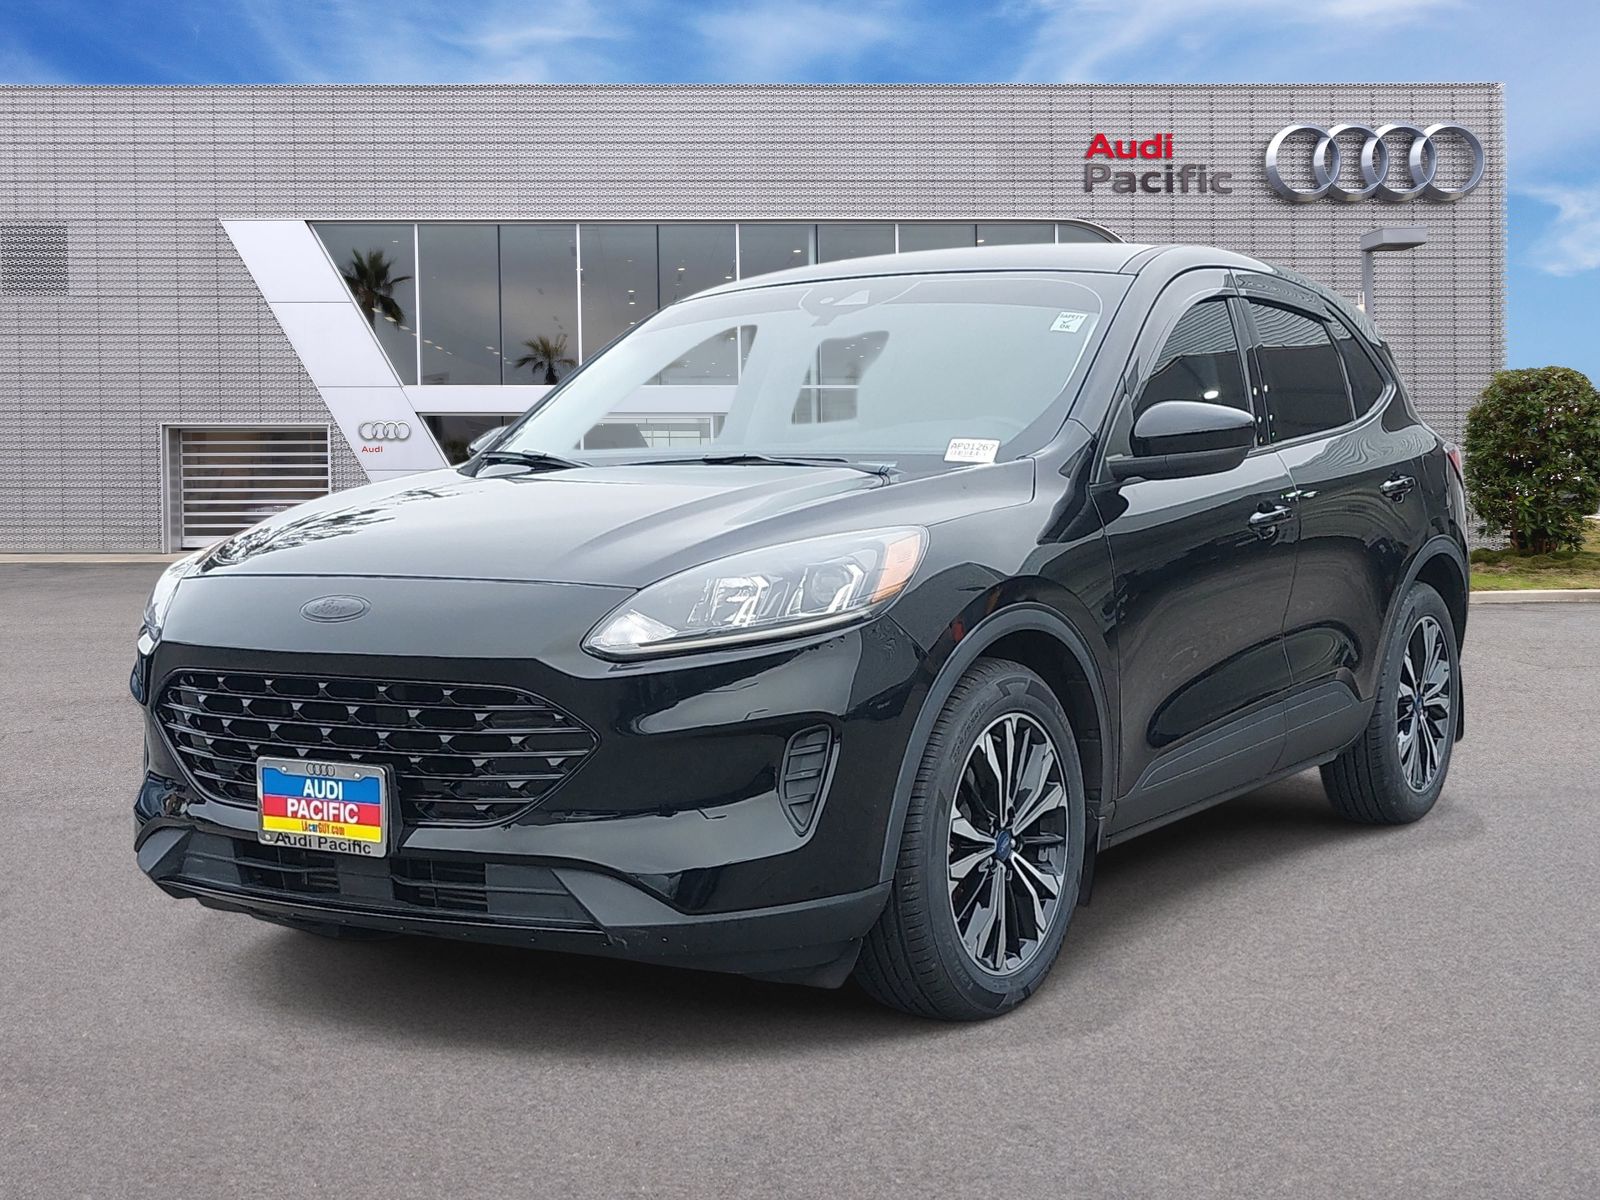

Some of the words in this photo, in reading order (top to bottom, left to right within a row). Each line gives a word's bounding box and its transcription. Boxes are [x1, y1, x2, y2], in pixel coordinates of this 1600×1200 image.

[1084, 133, 1173, 160] Audi
[1084, 163, 1233, 194] Pacific
[361, 445, 383, 453] Audi
[303, 778, 343, 801] AUDI
[286, 798, 359, 824] PACIFIC
[274, 832, 312, 848] Audi
[317, 836, 372, 855] Pacific
